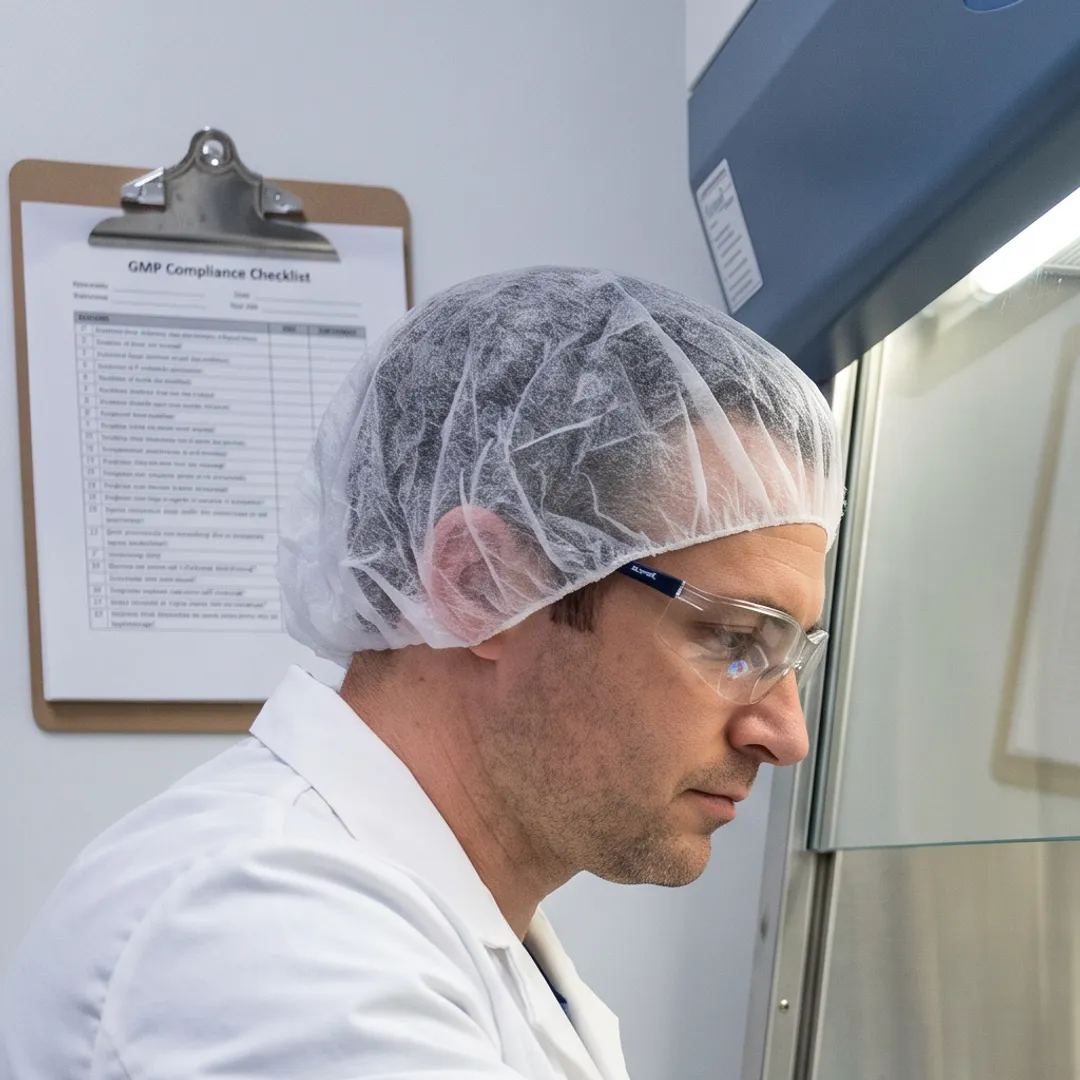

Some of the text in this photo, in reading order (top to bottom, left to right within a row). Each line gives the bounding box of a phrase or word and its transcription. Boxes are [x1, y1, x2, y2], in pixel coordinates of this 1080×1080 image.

[128, 260, 311, 283] GMP Compliance Checklist
